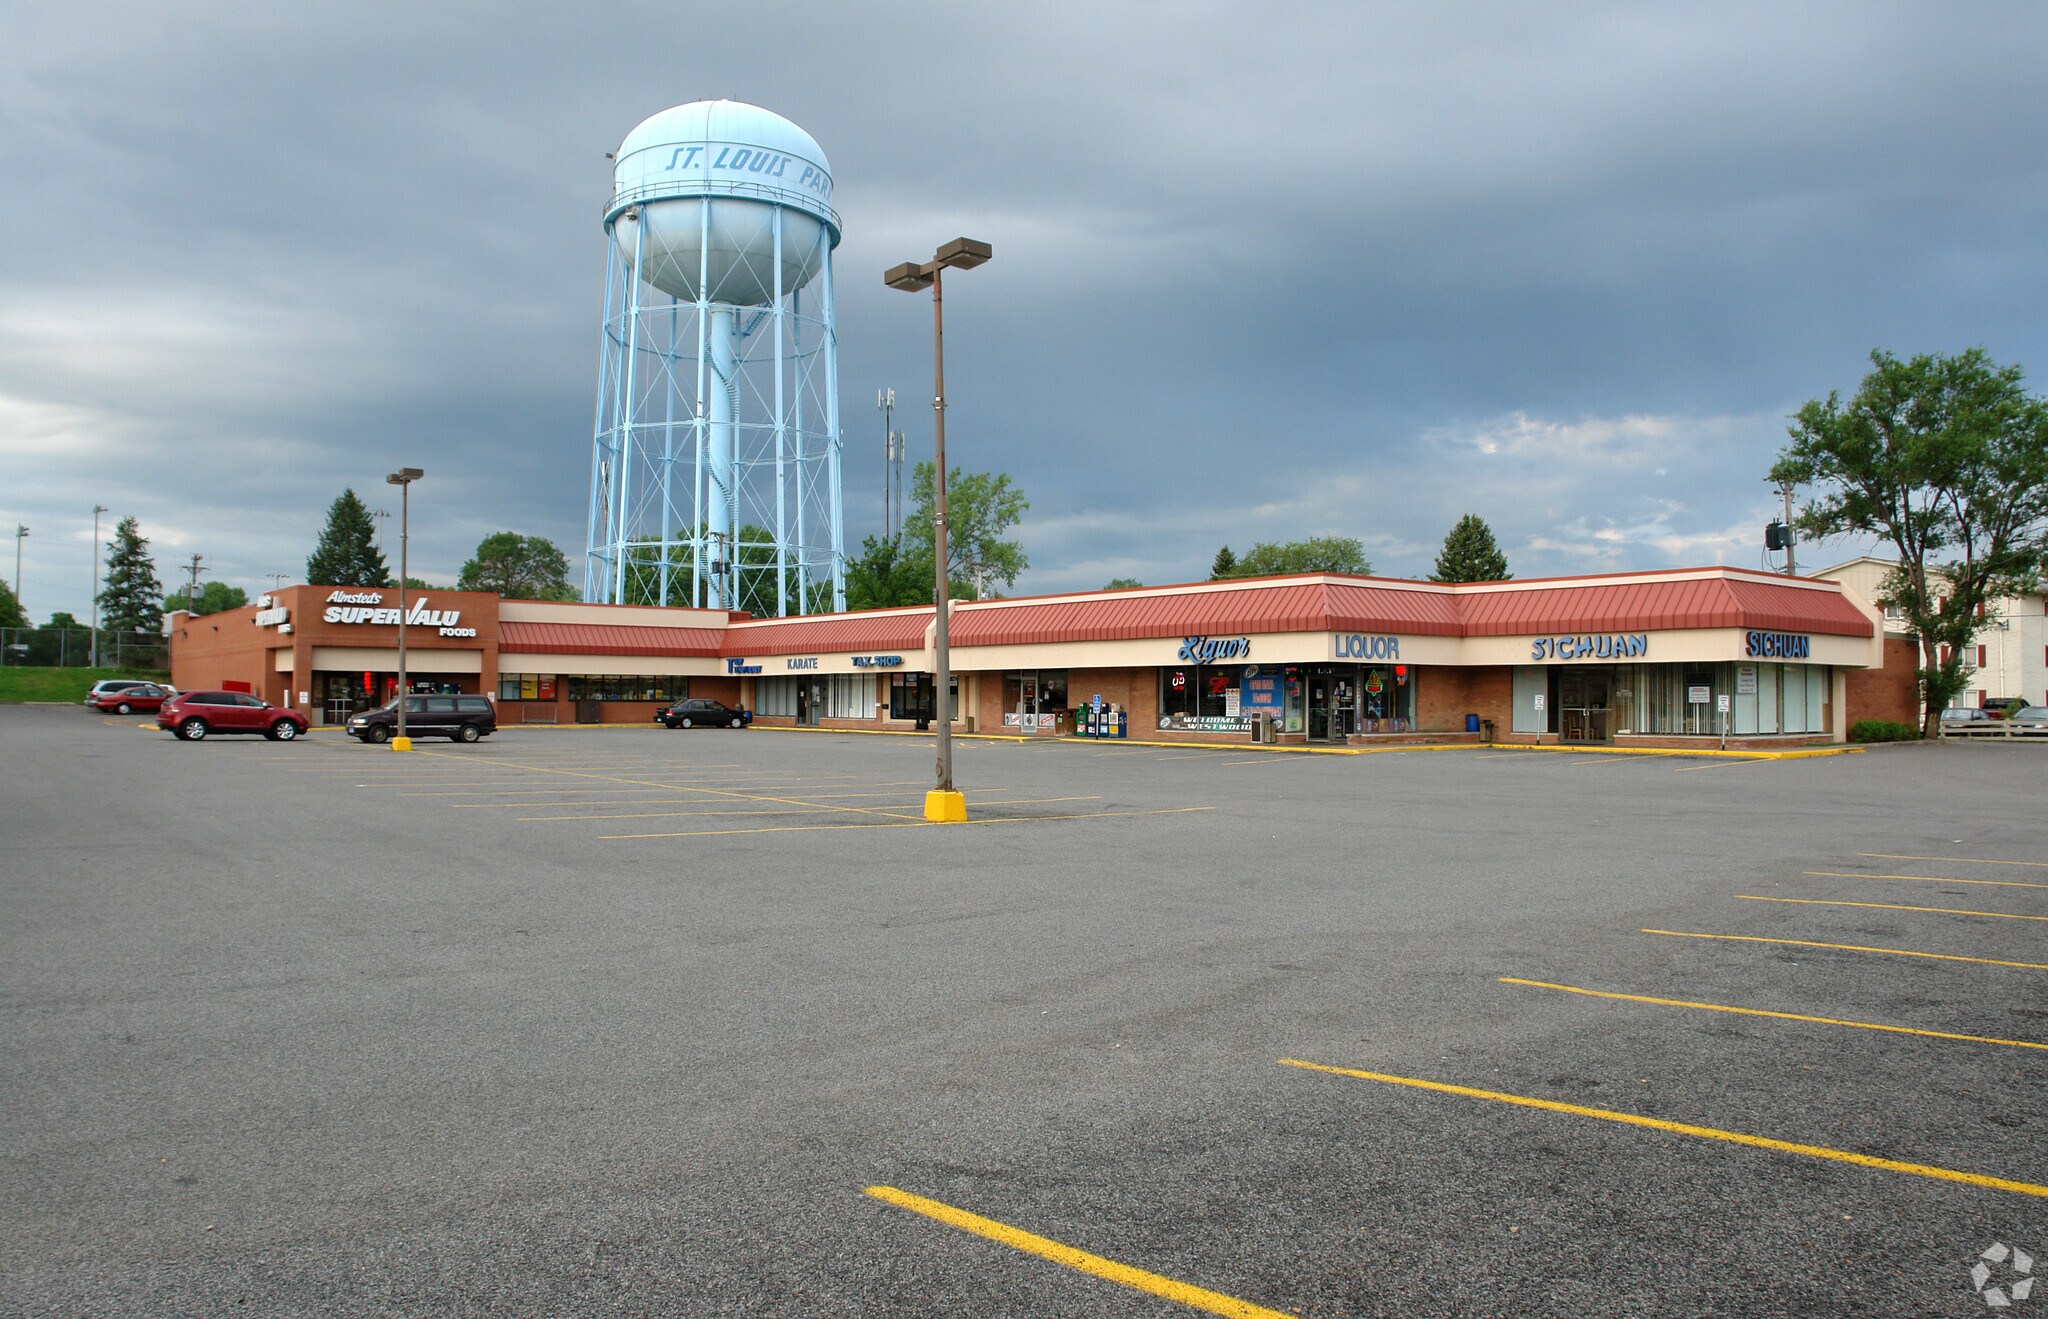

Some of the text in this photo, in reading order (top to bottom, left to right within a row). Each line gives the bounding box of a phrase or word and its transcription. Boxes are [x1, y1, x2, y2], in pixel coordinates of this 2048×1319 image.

[665, 146, 704, 171] ST.
[712, 147, 792, 177] LOUIS
[325, 590, 382, 604] Almsted's
[323, 597, 460, 627] SUPERVALU
[439, 627, 477, 638] FOODS
[1747, 631, 1811, 658] SICHUAN
[1177, 635, 1250, 665] Liquor
[1335, 634, 1400, 660] LIQUOR
[1531, 634, 1647, 660] SICHUAN
[786, 657, 818, 670] KARATE
[850, 655, 903, 668] TAX SHOP
